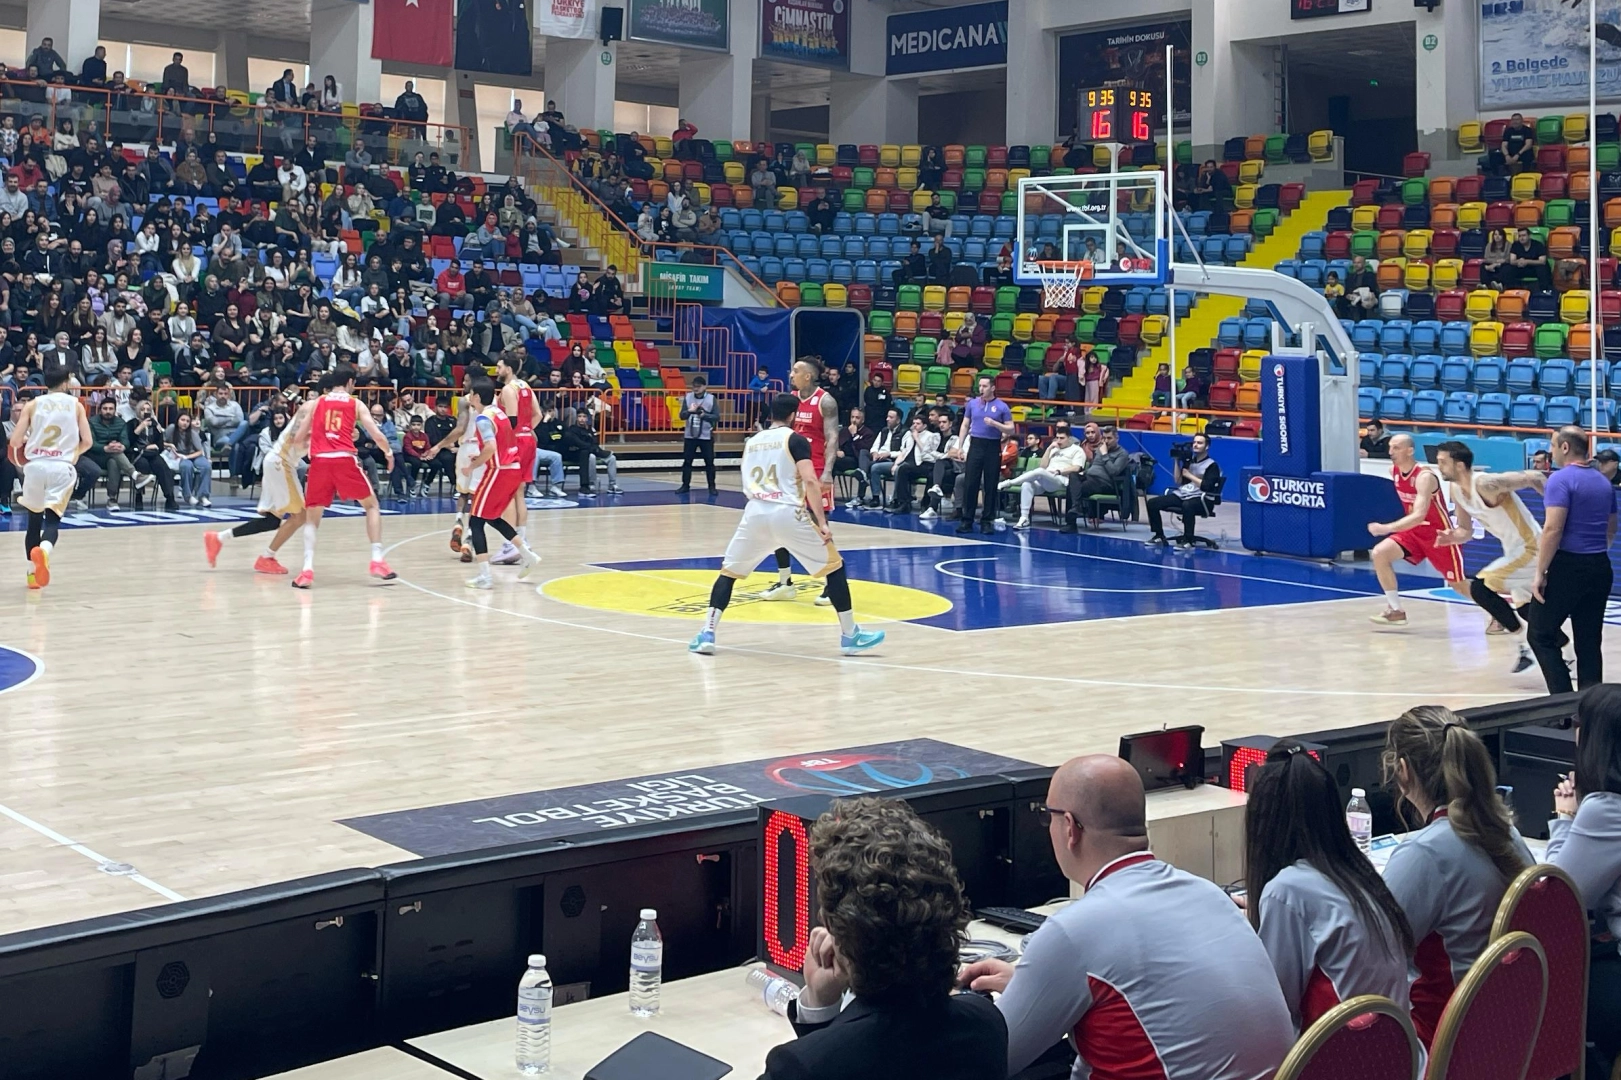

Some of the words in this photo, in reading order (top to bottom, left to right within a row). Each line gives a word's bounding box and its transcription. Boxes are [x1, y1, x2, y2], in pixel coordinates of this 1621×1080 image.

[891, 23, 999, 56] MEDICANA
[1135, 31, 1165, 42] DOKUSU
[1492, 61, 1502, 75] 2
[1506, 55, 1569, 74] Bölgede
[1092, 110, 1111, 139] 16
[1132, 111, 1149, 140] 16
[689, 274, 709, 284] TAKIM
[325, 409, 343, 431] 15
[41, 425, 62, 447] 2
[748, 441, 783, 454] METEHAN
[751, 464, 778, 491] 24
[472, 783, 748, 828] BASKETBOL
[581, 793, 777, 828] TÜRKİYE
[764, 810, 809, 972] 0
